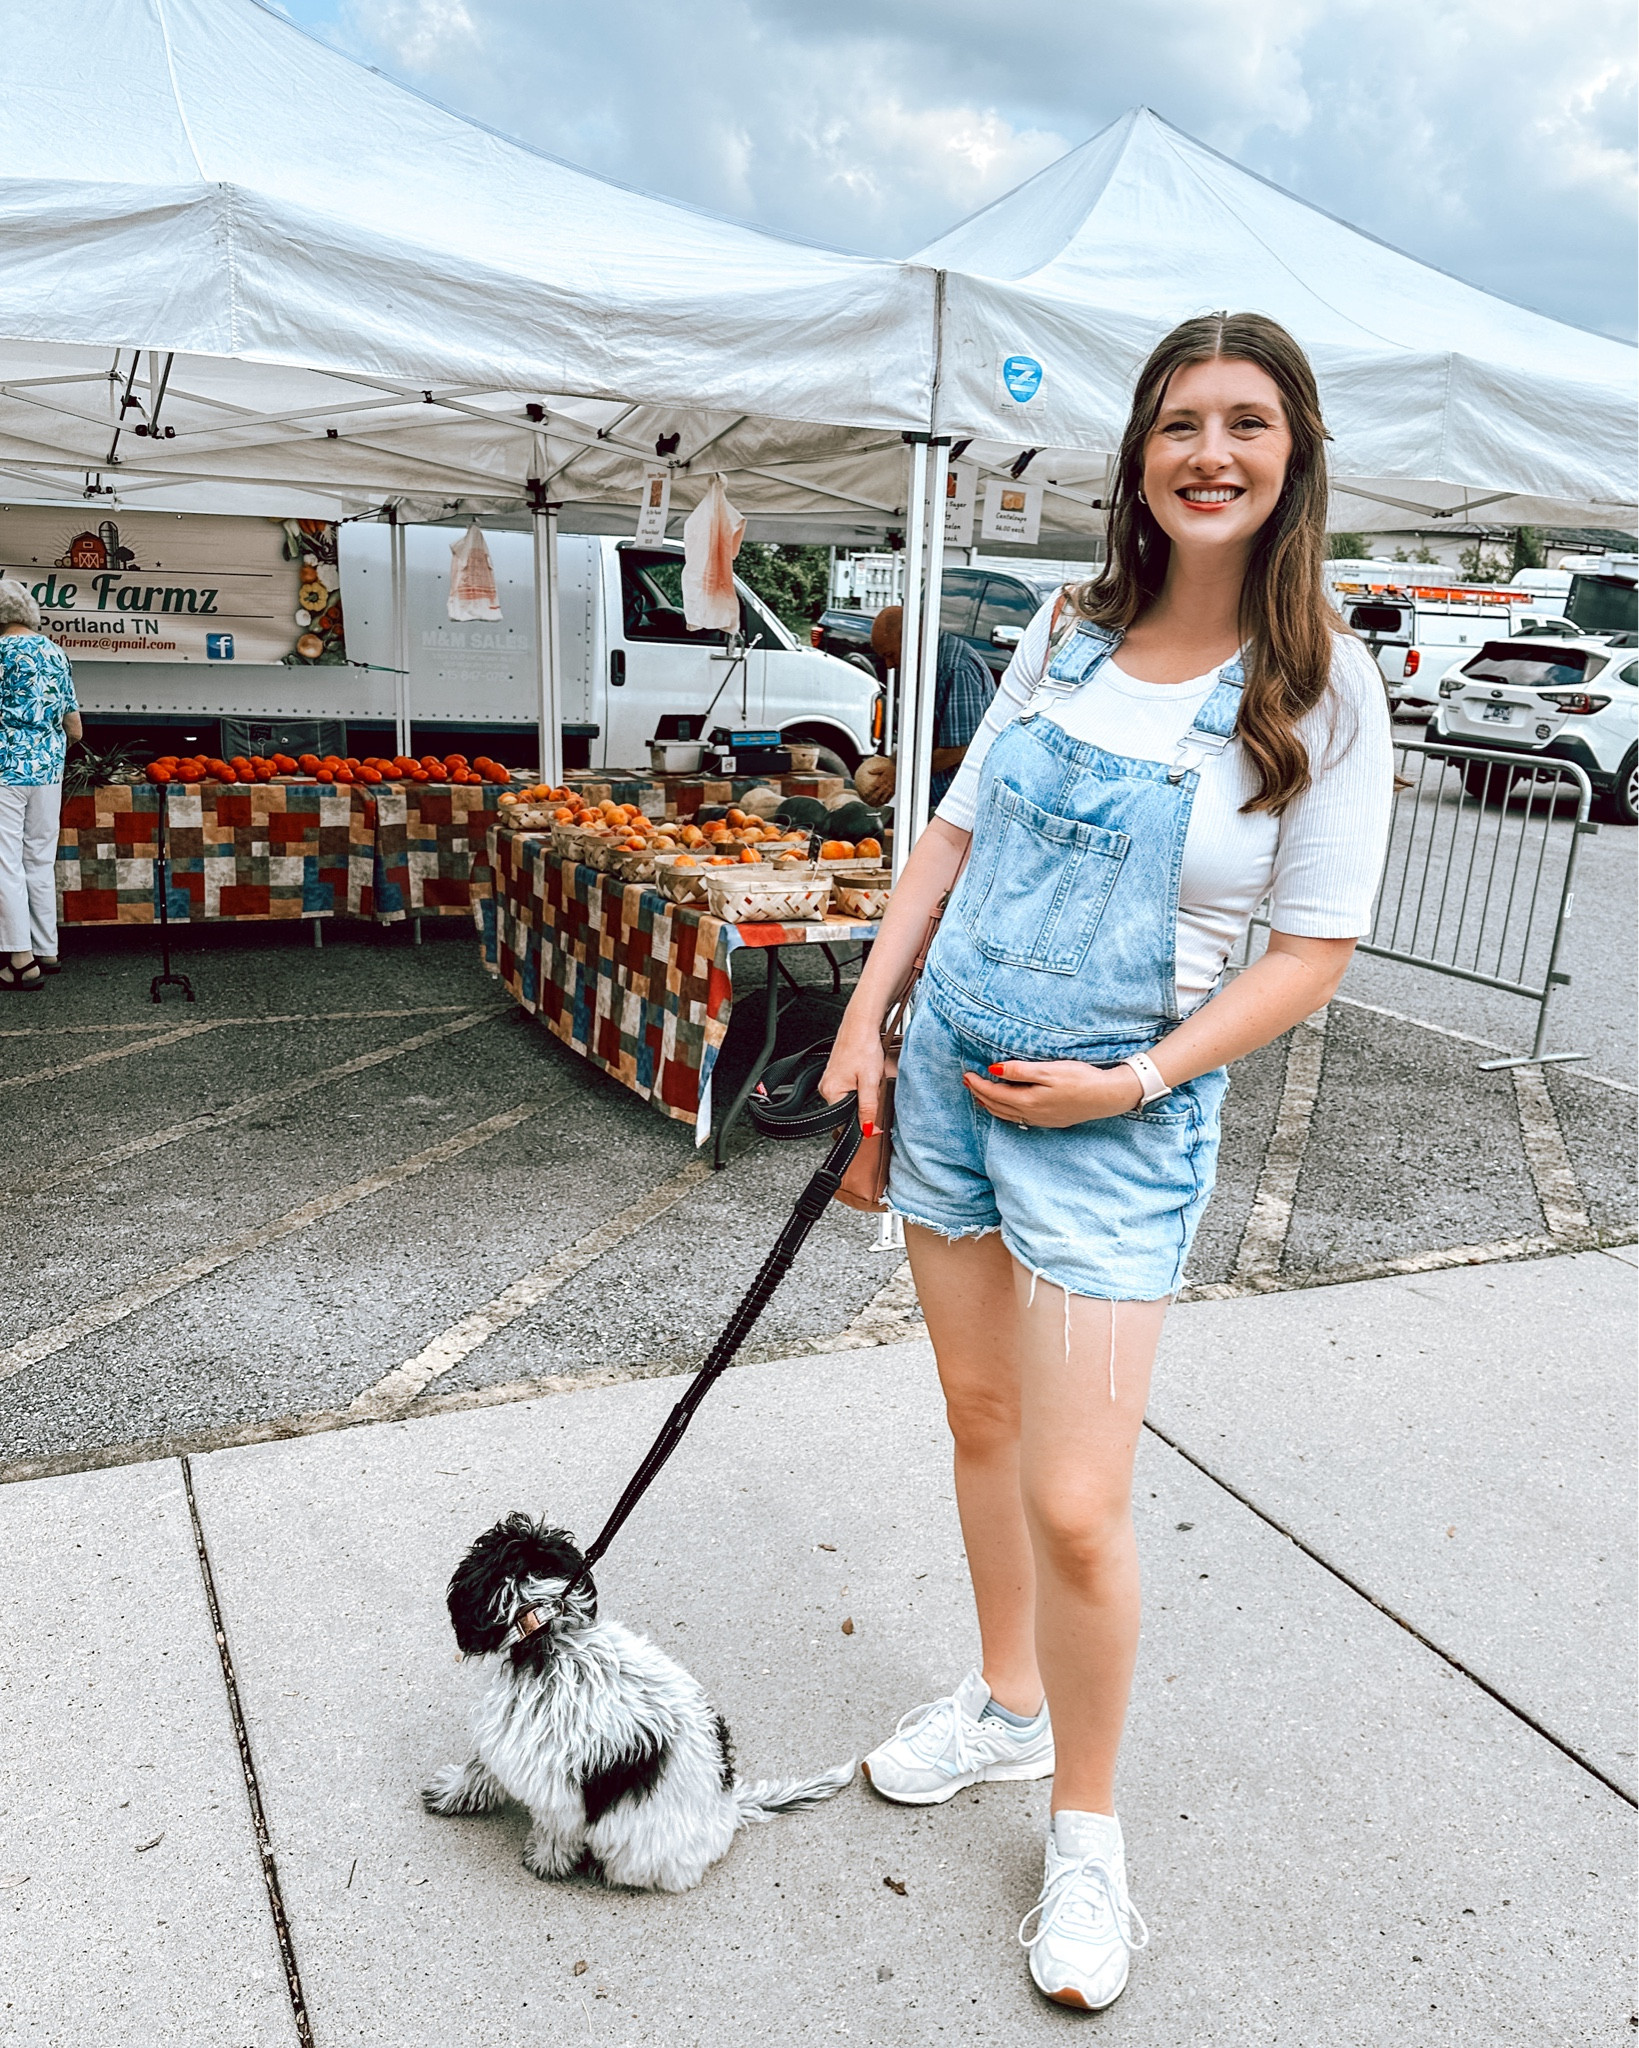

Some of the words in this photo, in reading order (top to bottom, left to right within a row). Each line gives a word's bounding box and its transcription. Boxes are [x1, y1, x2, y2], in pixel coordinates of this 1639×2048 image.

[995, 512, 1027, 523] Cantaloupe
[91, 573, 218, 613] Farmz
[38, 616, 125, 634] Portland
[131, 618, 158, 634] TN
